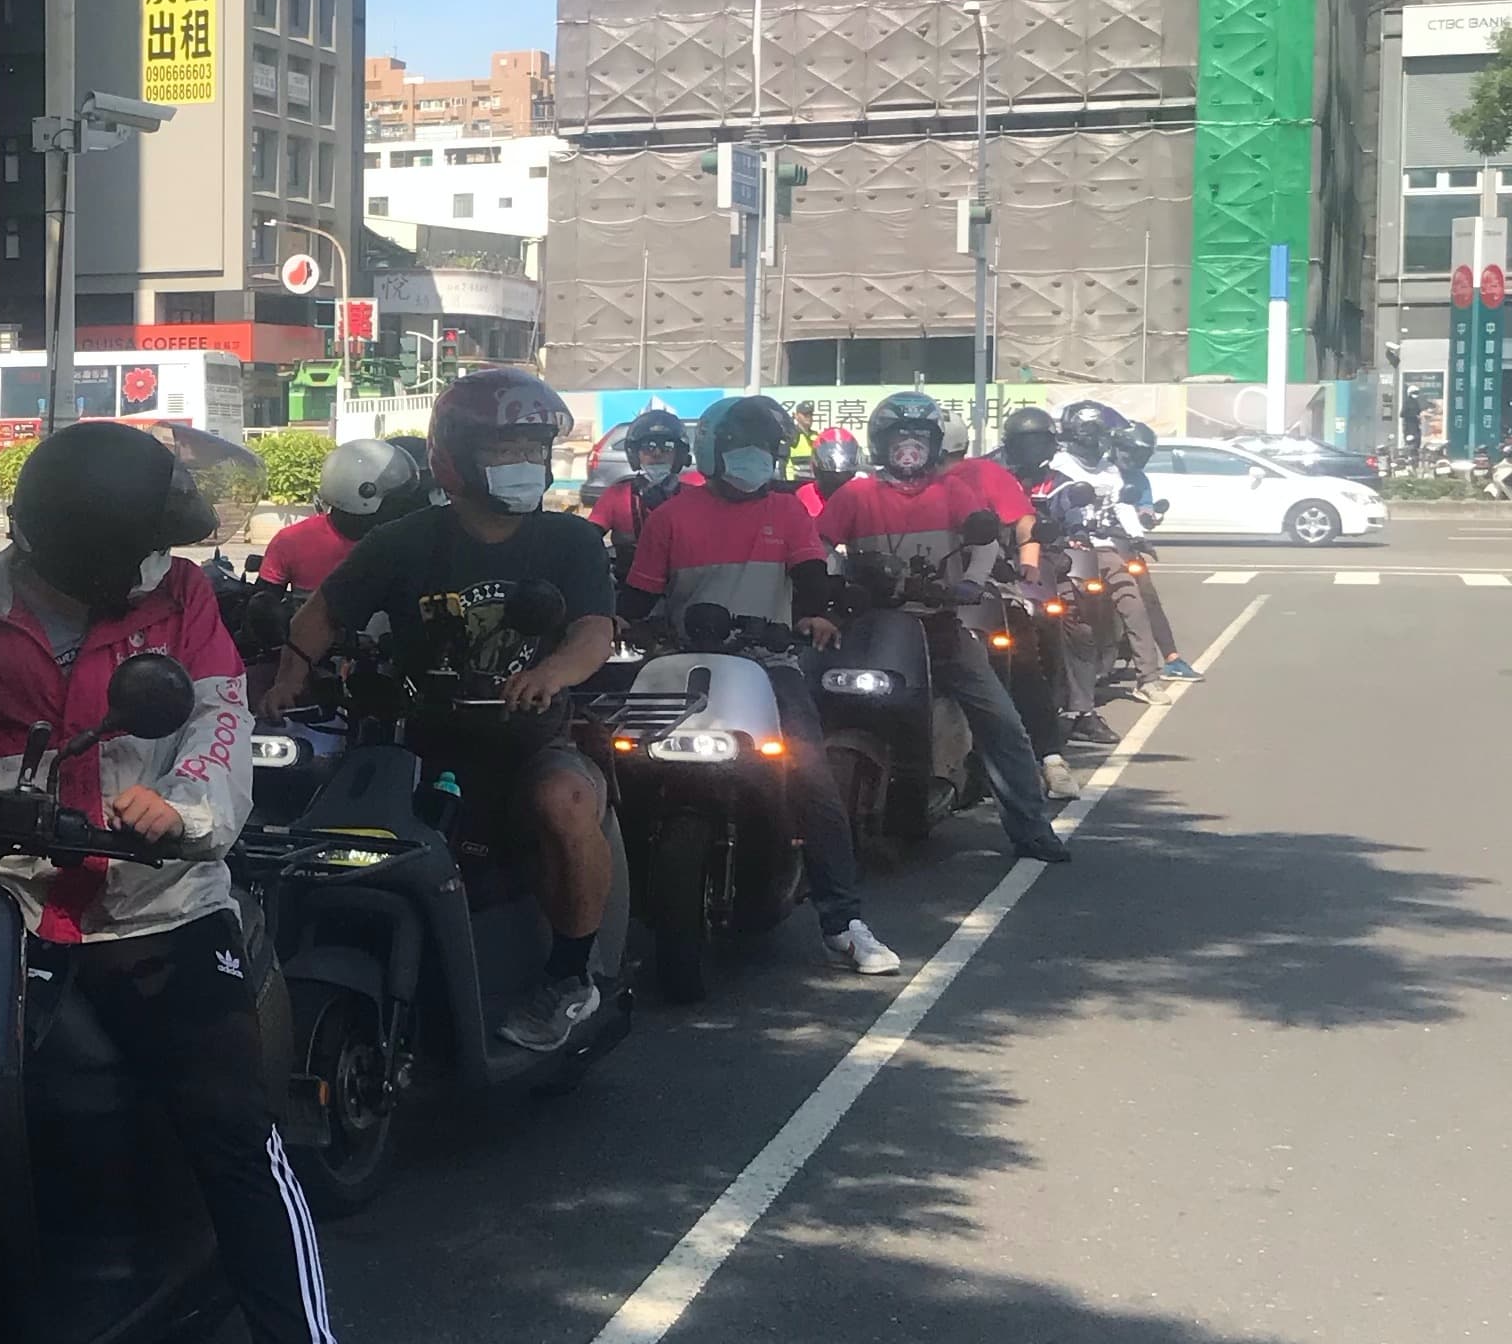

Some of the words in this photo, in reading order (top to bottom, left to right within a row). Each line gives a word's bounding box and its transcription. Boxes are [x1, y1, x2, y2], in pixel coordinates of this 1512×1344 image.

[1427, 18, 1465, 31] CTBC
[146, 9, 212, 62] 出租
[145, 63, 212, 83] 0906666603
[145, 82, 212, 102] 0906886000
[142, 337, 208, 351] COFFEE
